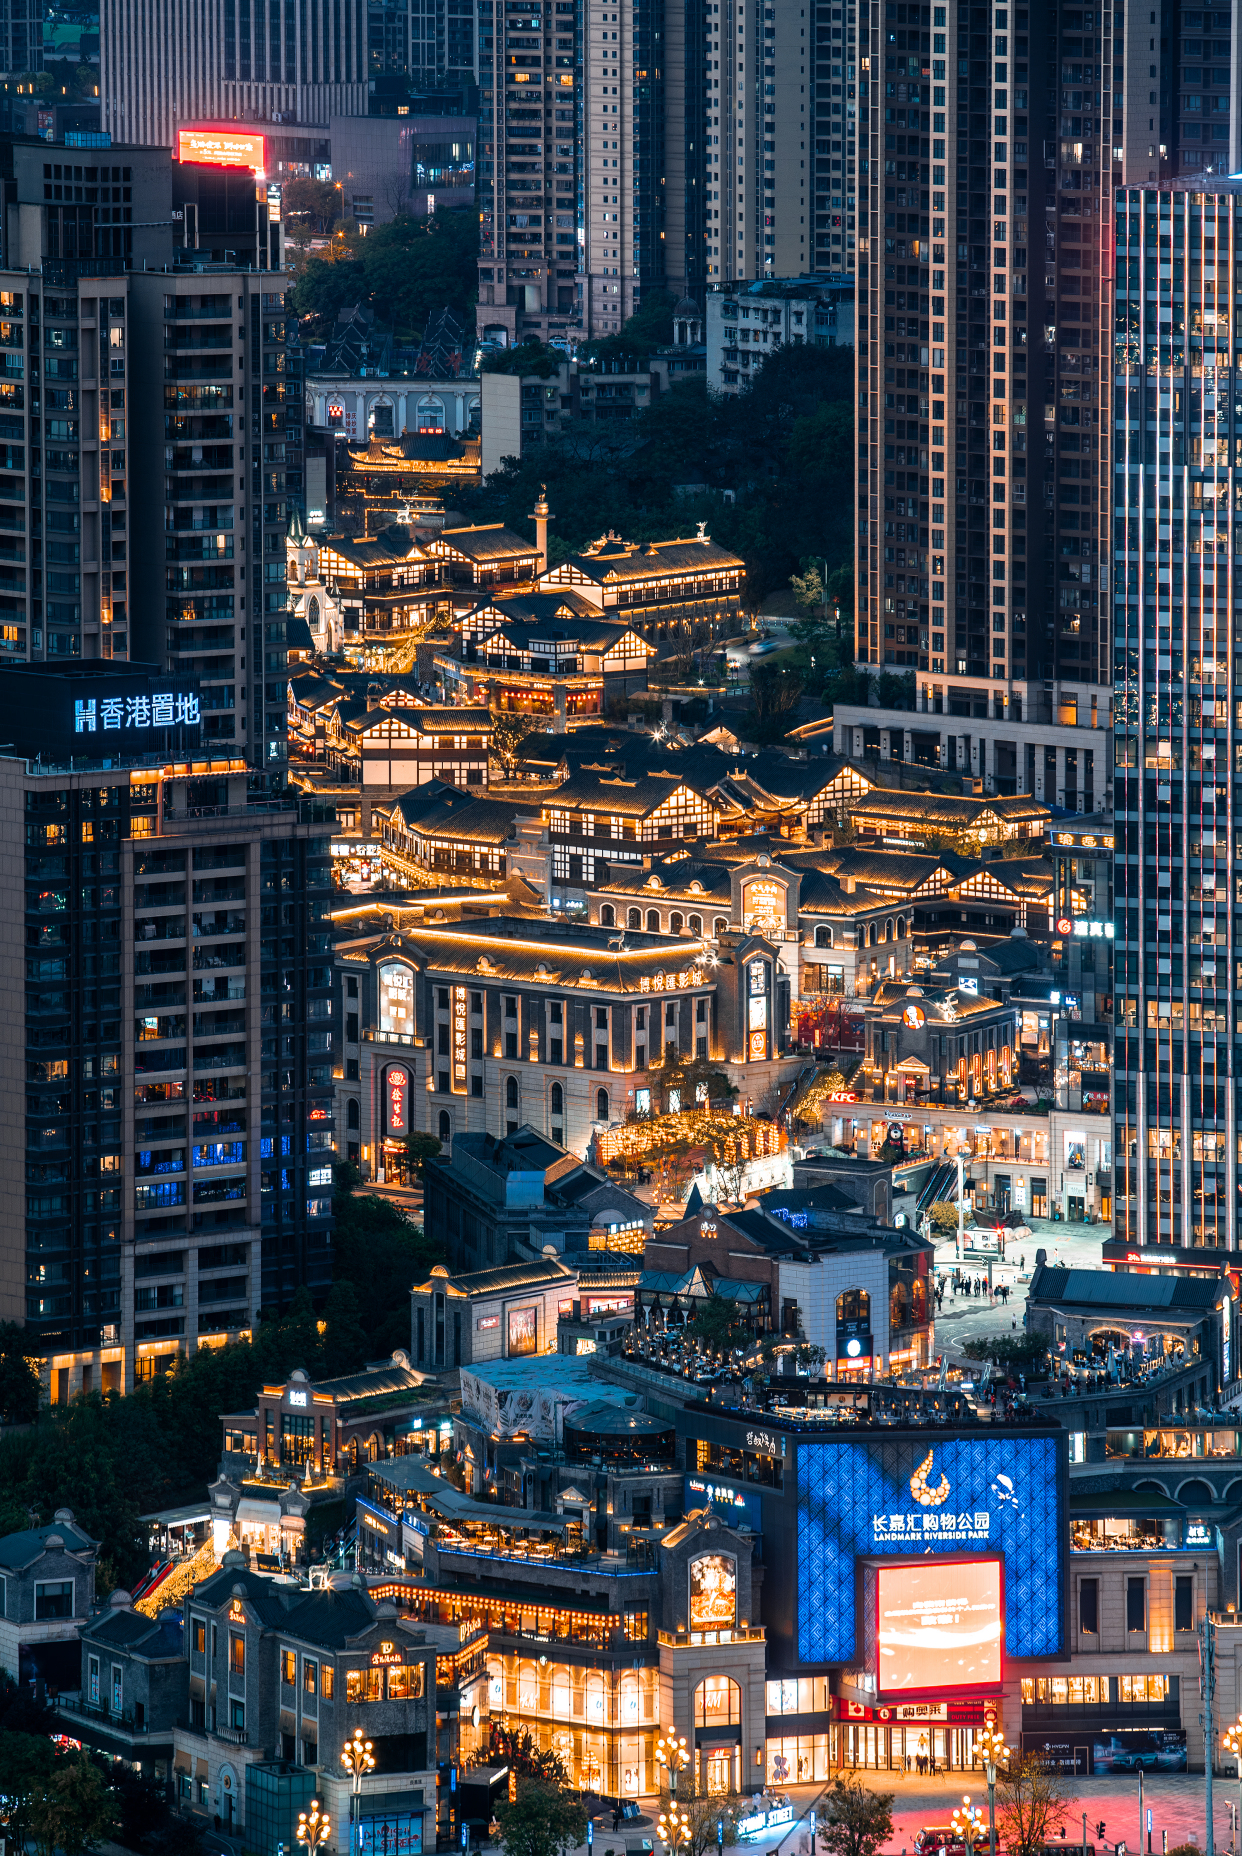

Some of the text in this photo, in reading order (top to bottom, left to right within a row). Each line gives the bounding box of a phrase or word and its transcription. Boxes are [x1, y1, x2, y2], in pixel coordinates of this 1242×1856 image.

[100, 692, 200, 729] 香港置地
[829, 1091, 856, 1103] KFC
[872, 1512, 989, 1532] 长嘉汇购物公园
[874, 1530, 989, 1541] LANDMARK RIVERSIDE PARK
